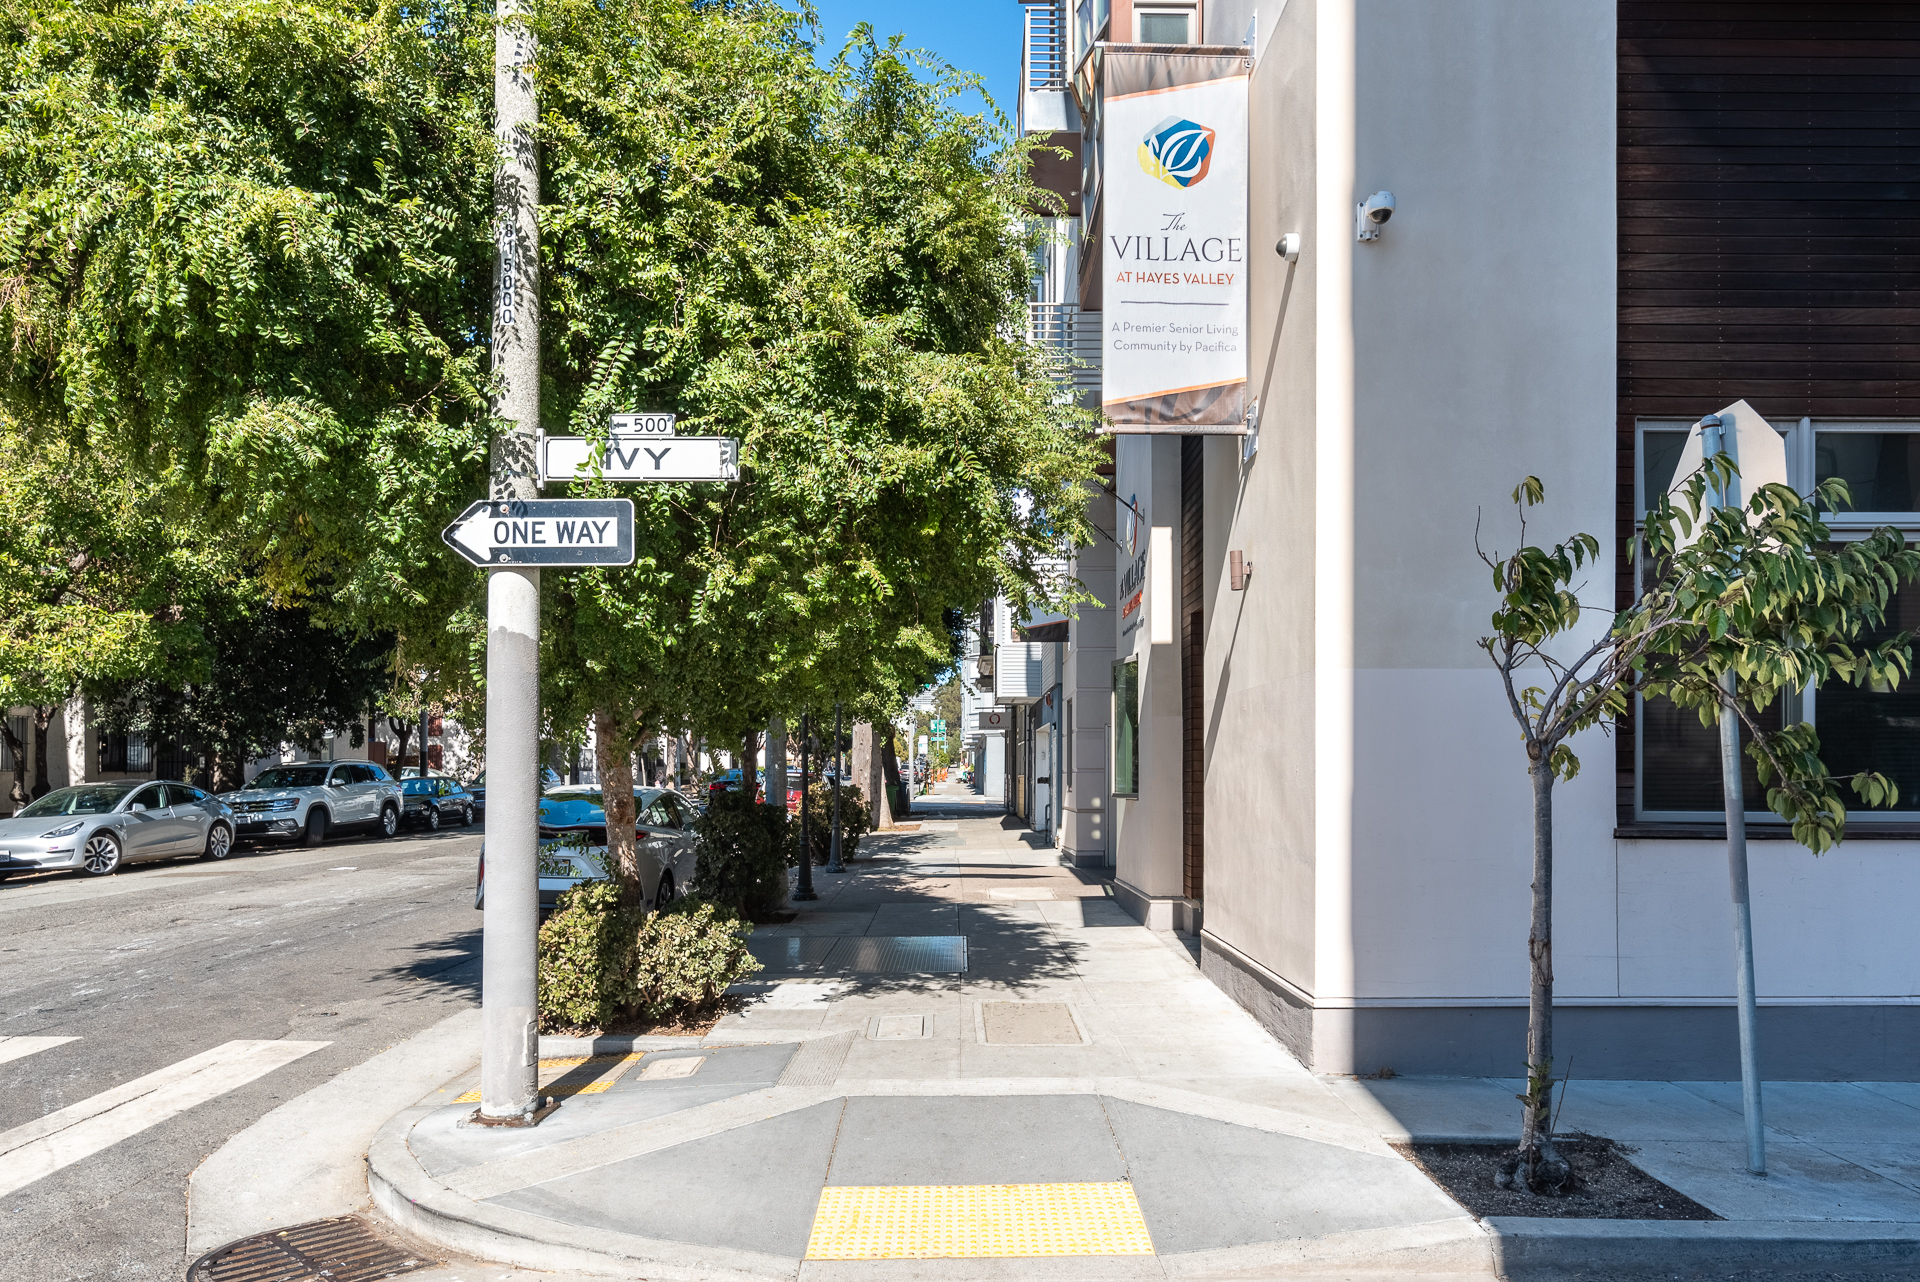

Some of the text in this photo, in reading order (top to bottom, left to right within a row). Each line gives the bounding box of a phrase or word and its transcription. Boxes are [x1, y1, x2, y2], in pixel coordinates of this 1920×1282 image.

[1160, 212, 1188, 231] The
[1110, 235, 1243, 262] VILLAGE
[502, 223, 513, 324] 815000
[1116, 271, 1235, 285] AT HAYES VALLEY
[1111, 321, 1239, 337] A Premier Senior Living
[1113, 339, 1238, 354] Community by Pacifica
[634, 417, 667, 433] 500
[604, 447, 672, 471] IVY
[493, 520, 611, 545] ONE WAY
